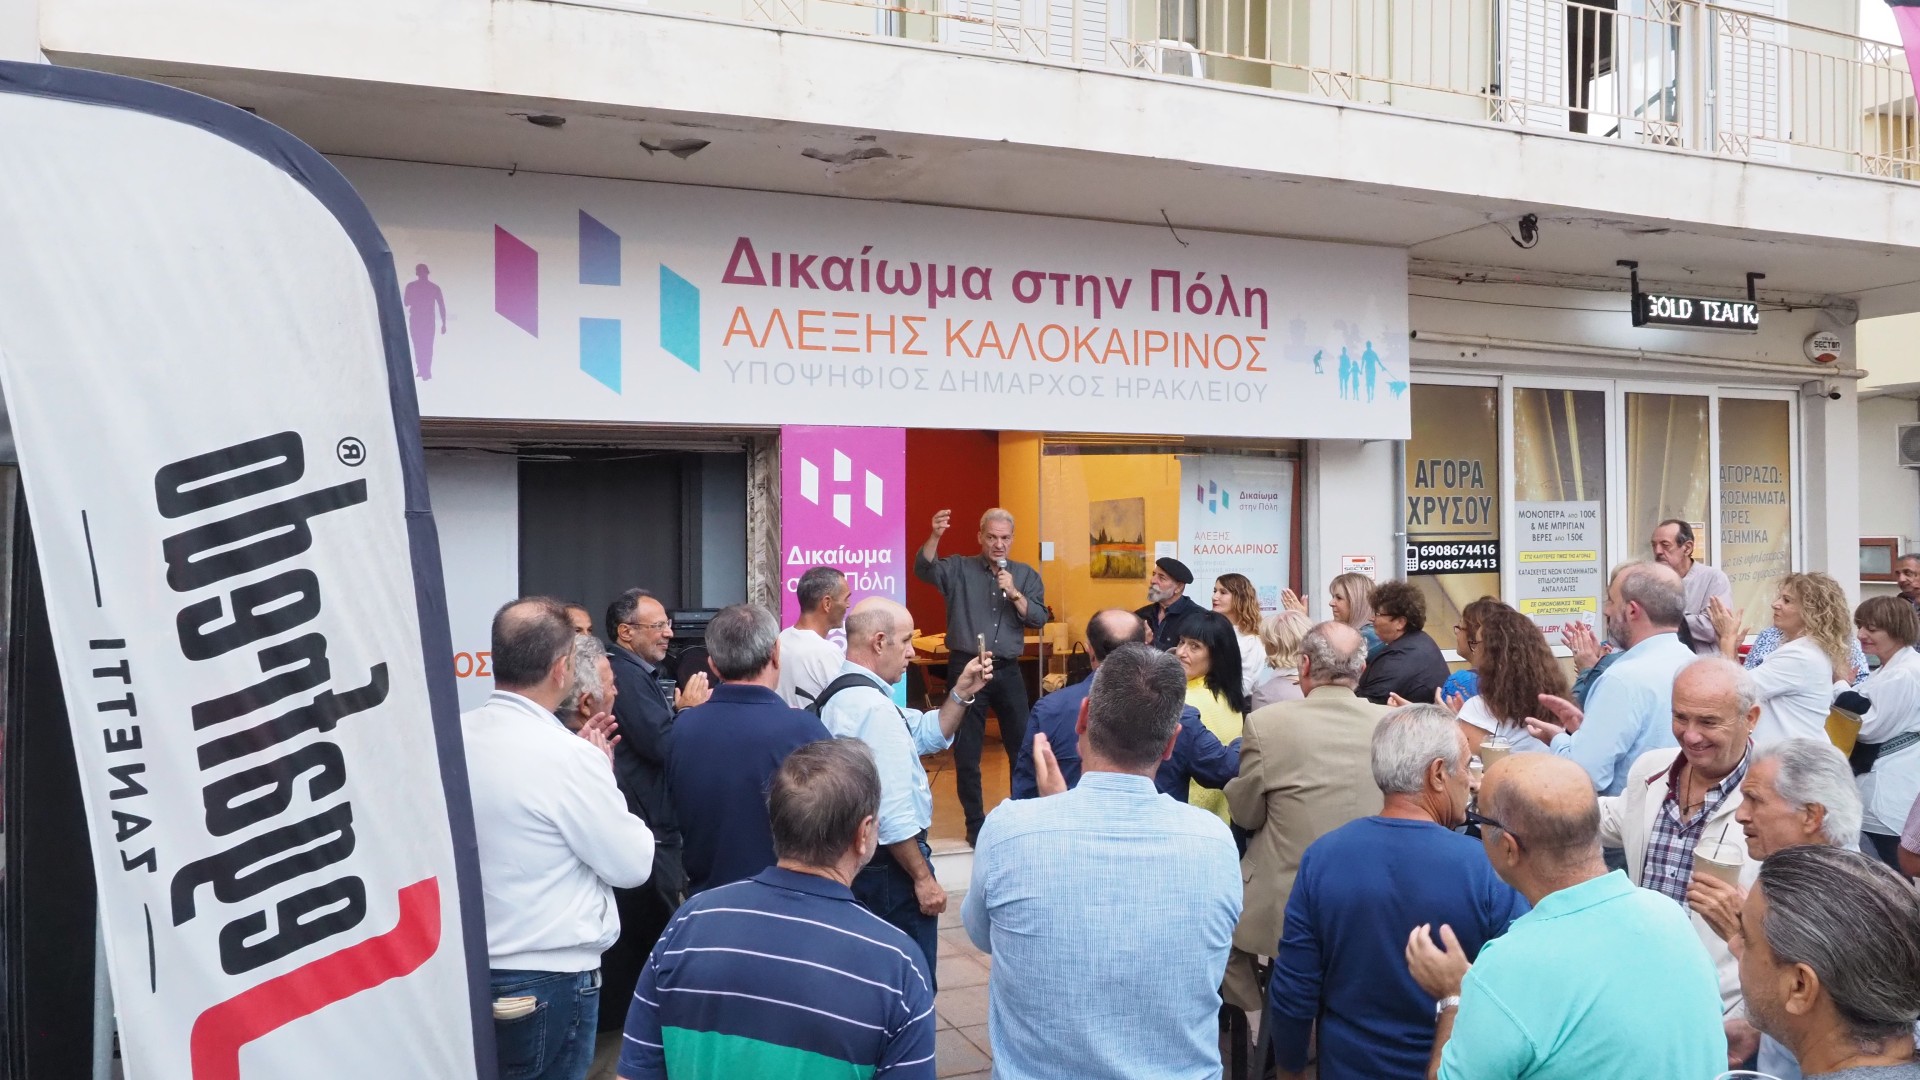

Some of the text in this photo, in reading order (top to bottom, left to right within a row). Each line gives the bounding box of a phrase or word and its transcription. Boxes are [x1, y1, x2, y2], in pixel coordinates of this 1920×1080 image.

[721, 236, 1268, 330] Δικαίωμα στην Πόλη
[722, 306, 1267, 372] ΑΛΕΞΗΣ ΚΑΛΟΚΑΙΡΙΝΟΣ
[723, 360, 1268, 403] ΥΠΟΨΗΦΙΟΣ ΔΗΜΑΡΧΟΣ ΗΡΑΚΛΕΙΟΥ
[1415, 459, 1484, 489] ΑΓΟΡΑ
[1719, 465, 1782, 483] ΑΓΟΡΑΖΩ:
[1240, 491, 1278, 501] Δικαίωμα
[1720, 490, 1786, 504] ΚΟΣΜΗΜΑΤΑ
[1240, 502, 1278, 512] στην Πόλη
[1407, 496, 1491, 525] ΧΡΥΣΟΥ
[1518, 510, 1565, 519] ΜΟΝΟΠΕΤΡΑ
[1580, 510, 1596, 519] 100€
[1720, 510, 1751, 524] ΛΙΡΕΣ
[1531, 522, 1536, 530] &
[1538, 522, 1549, 530] ΜΕ
[1194, 531, 1230, 541] ΑΛΕΞΗΣ
[1532, 533, 1552, 542] ΒΕΡΕΣ
[1567, 533, 1584, 542] 150€
[1720, 529, 1769, 544] ΑΣΗΜΙΚΑ
[786, 544, 892, 568] Δικαίωμα
[1193, 544, 1279, 555] ΚΑΛΟΚΑΙΡΙΝΟΣ
[1420, 544, 1496, 557] 6908674416
[1420, 558, 1497, 570] 6908674413
[844, 571, 895, 595] Πόλη
